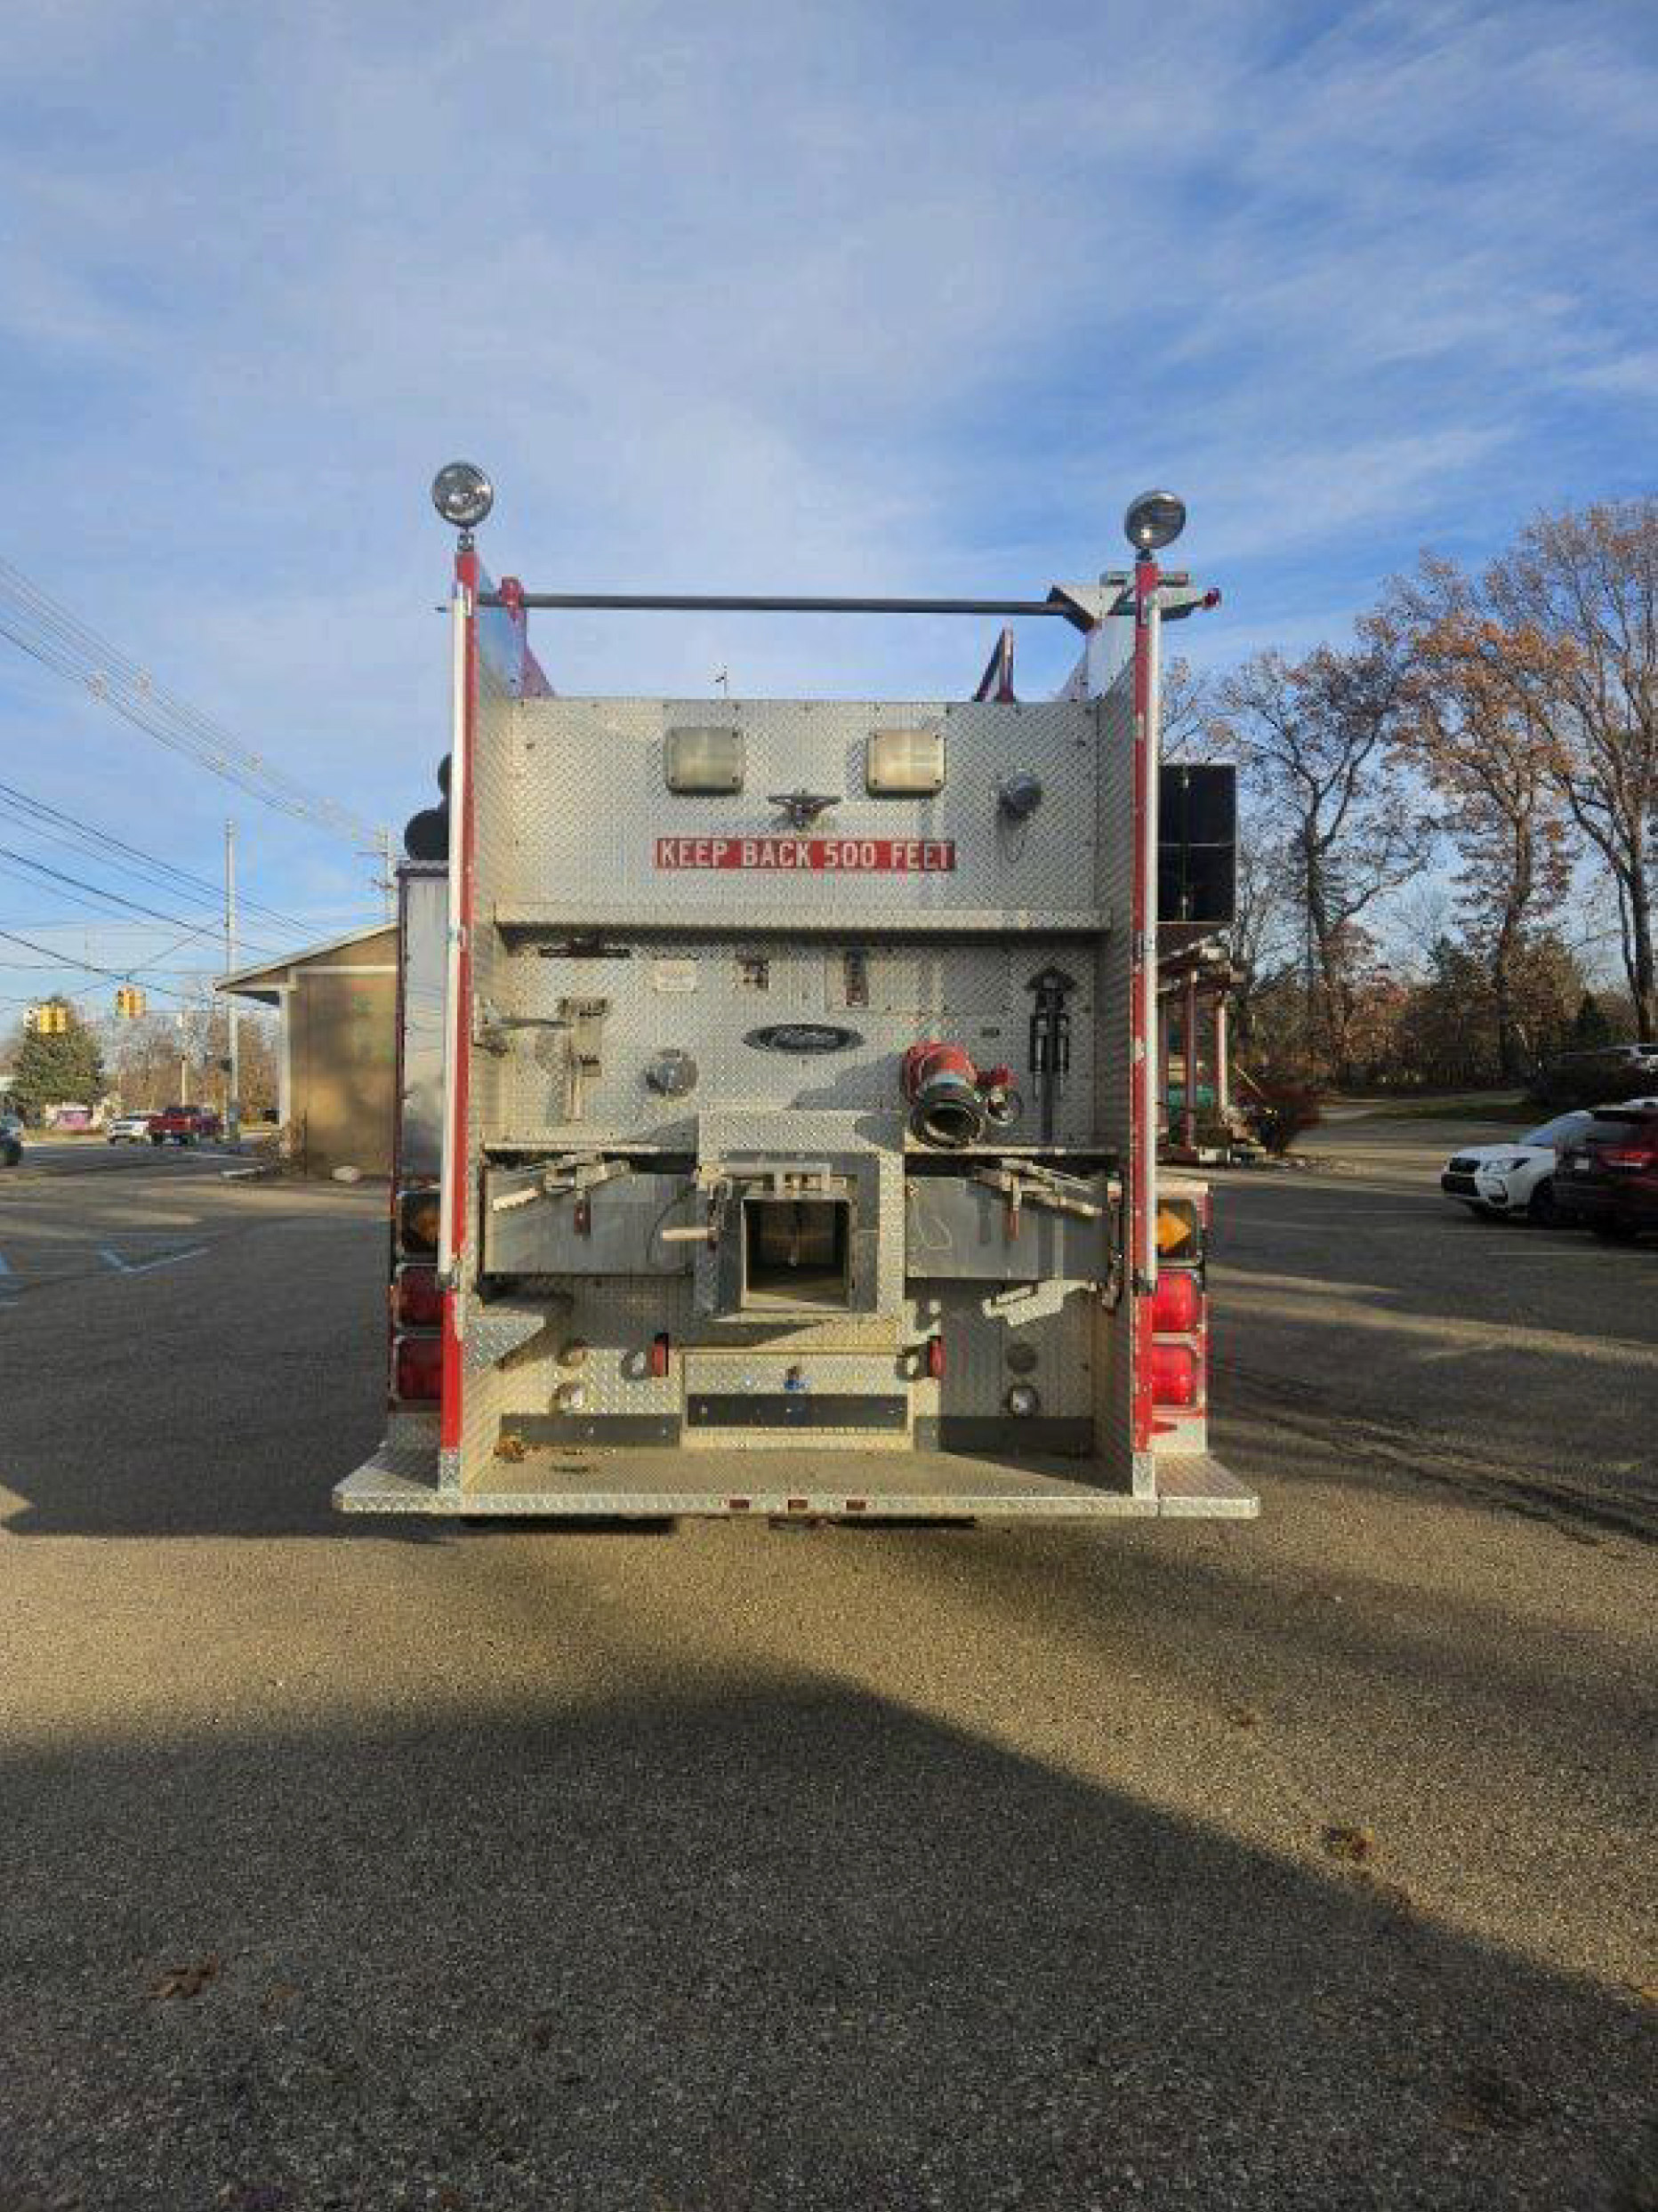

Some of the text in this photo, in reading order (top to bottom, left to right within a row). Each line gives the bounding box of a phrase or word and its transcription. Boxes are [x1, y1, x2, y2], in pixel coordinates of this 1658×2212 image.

[660, 841, 954, 869] KEEP BACK 500 FEET
